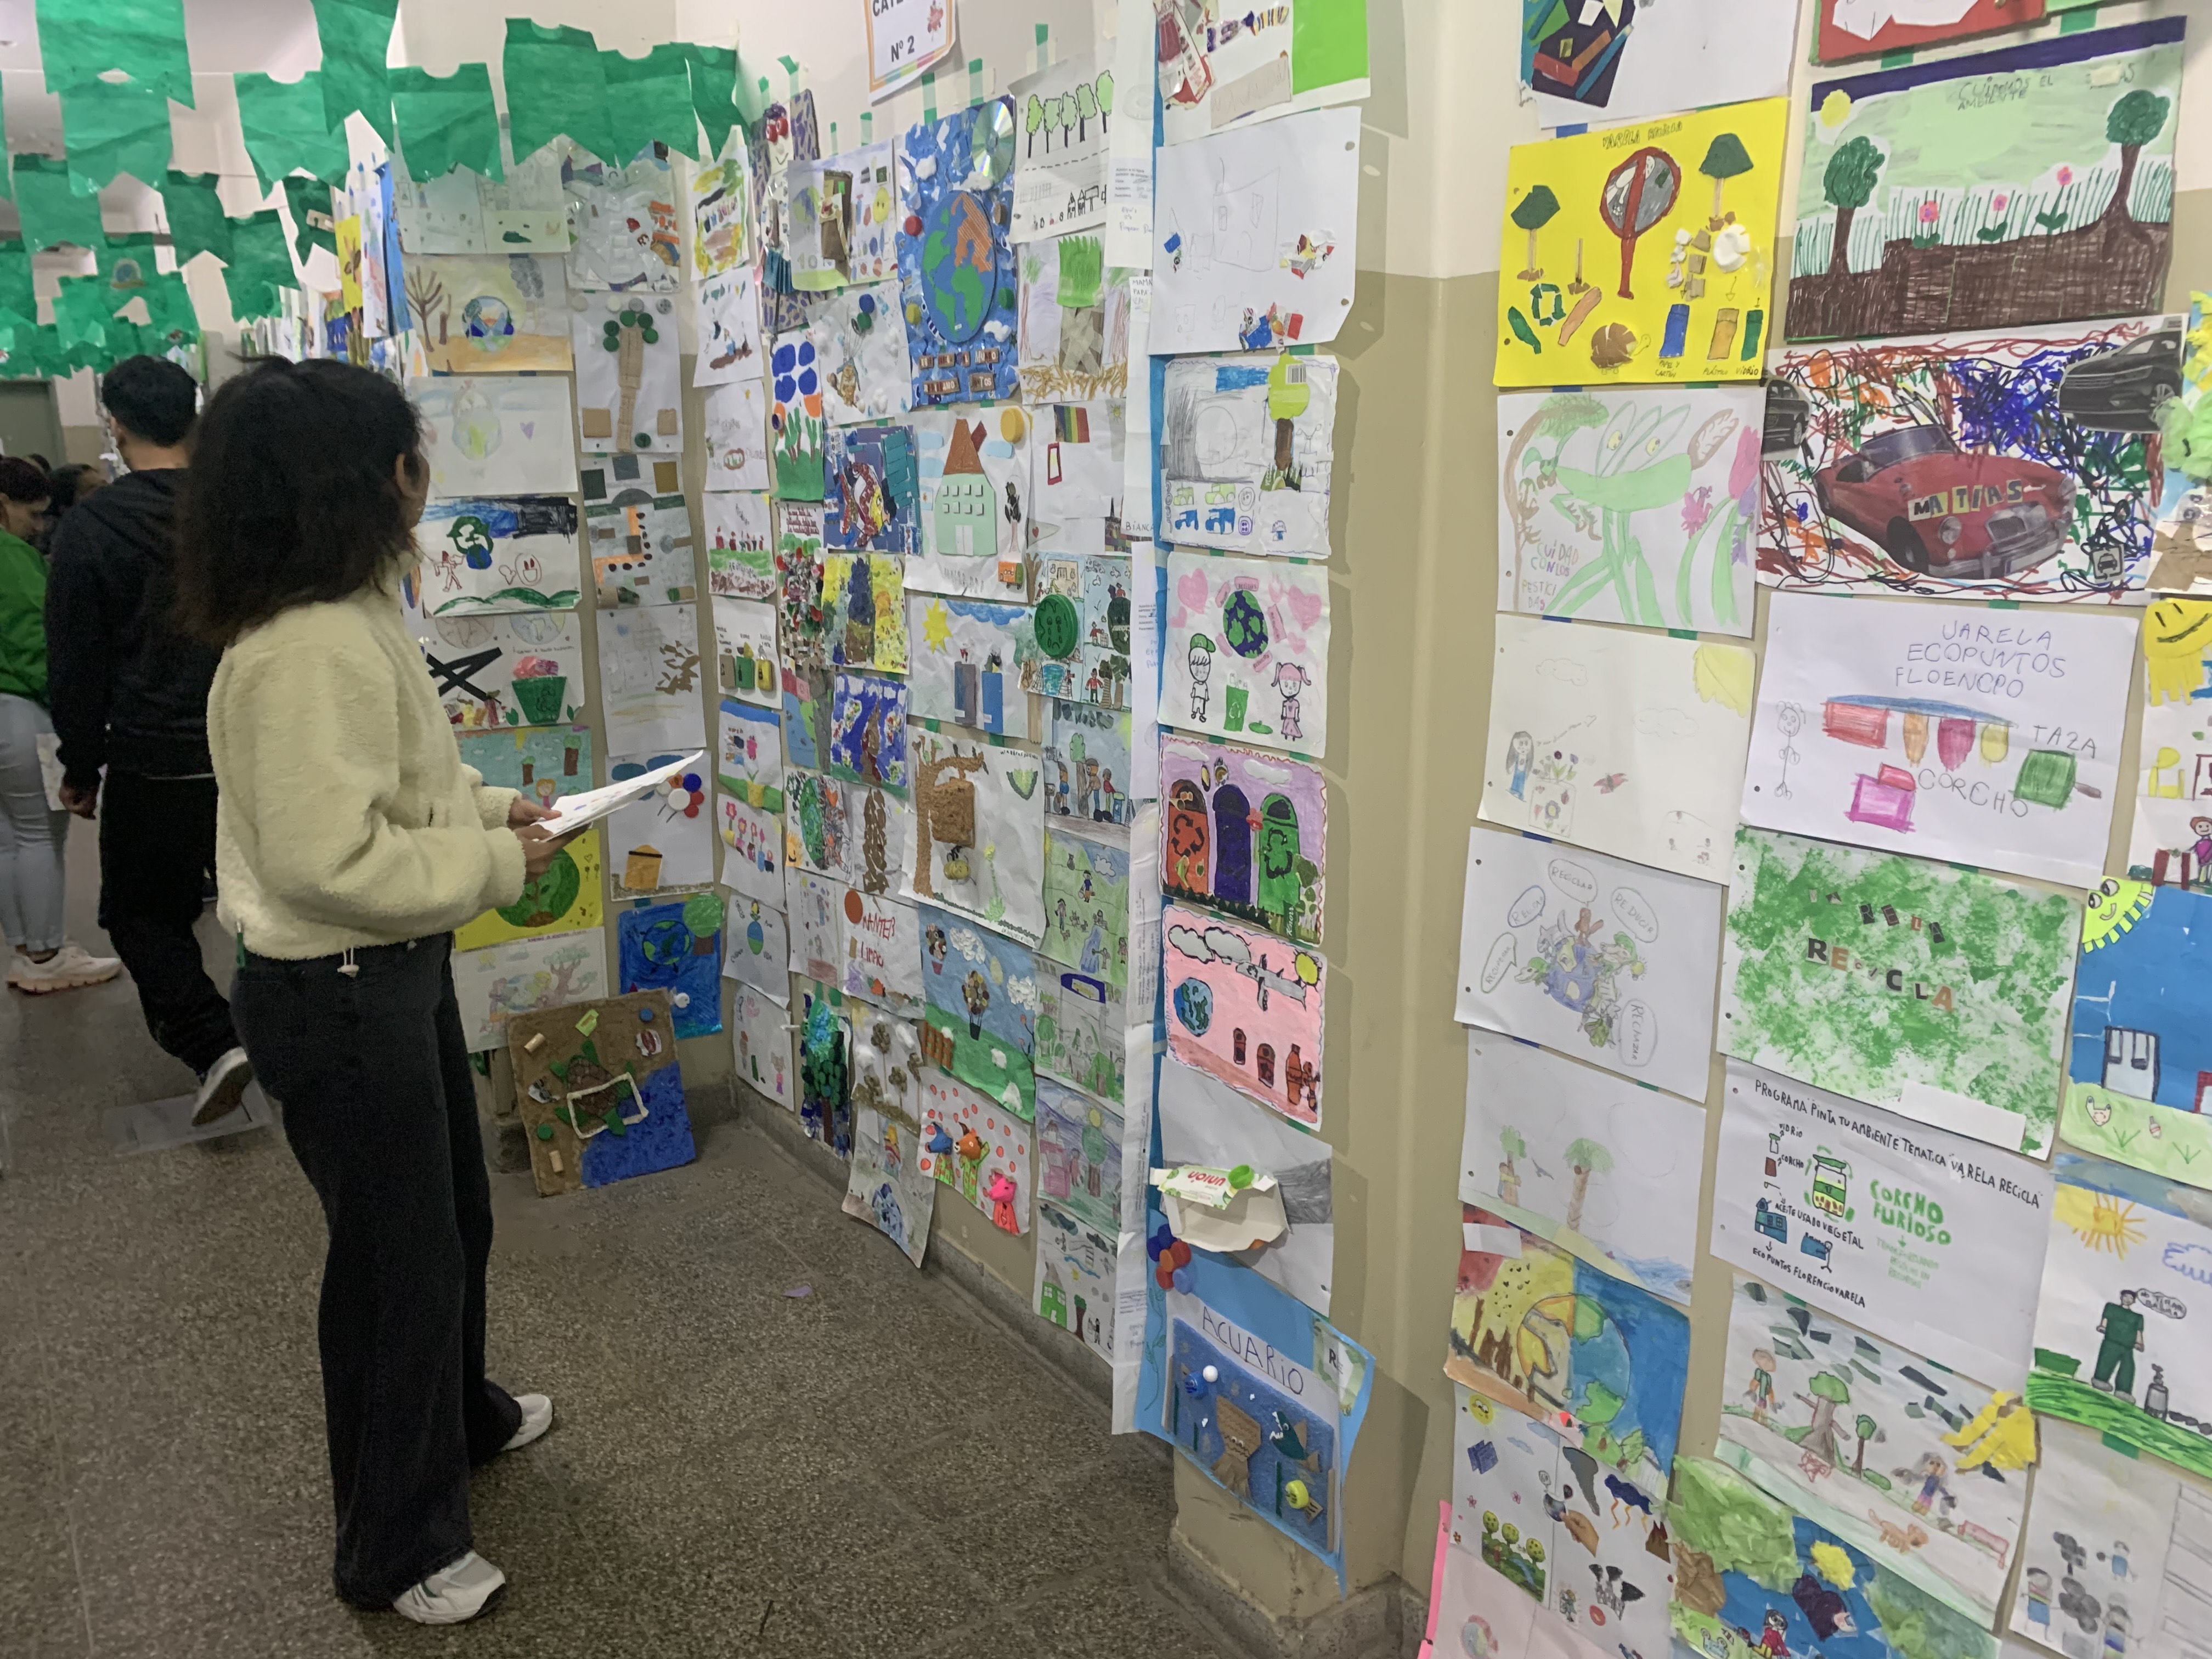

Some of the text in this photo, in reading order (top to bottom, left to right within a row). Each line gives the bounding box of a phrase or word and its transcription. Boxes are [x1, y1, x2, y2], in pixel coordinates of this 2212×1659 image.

[907, 35, 915, 54] 2
[1914, 481, 2022, 516] MATIAS
[1908, 643, 2067, 678] ECOPUNTOS
[1919, 769, 2028, 817] CORCHO
[1756, 1079, 1807, 1113] PROGRAMA
[1839, 1116, 1849, 1126] TU
[1822, 1223, 1864, 1250] VEGETAL
[1874, 1200, 1952, 1245] FURIOSO
